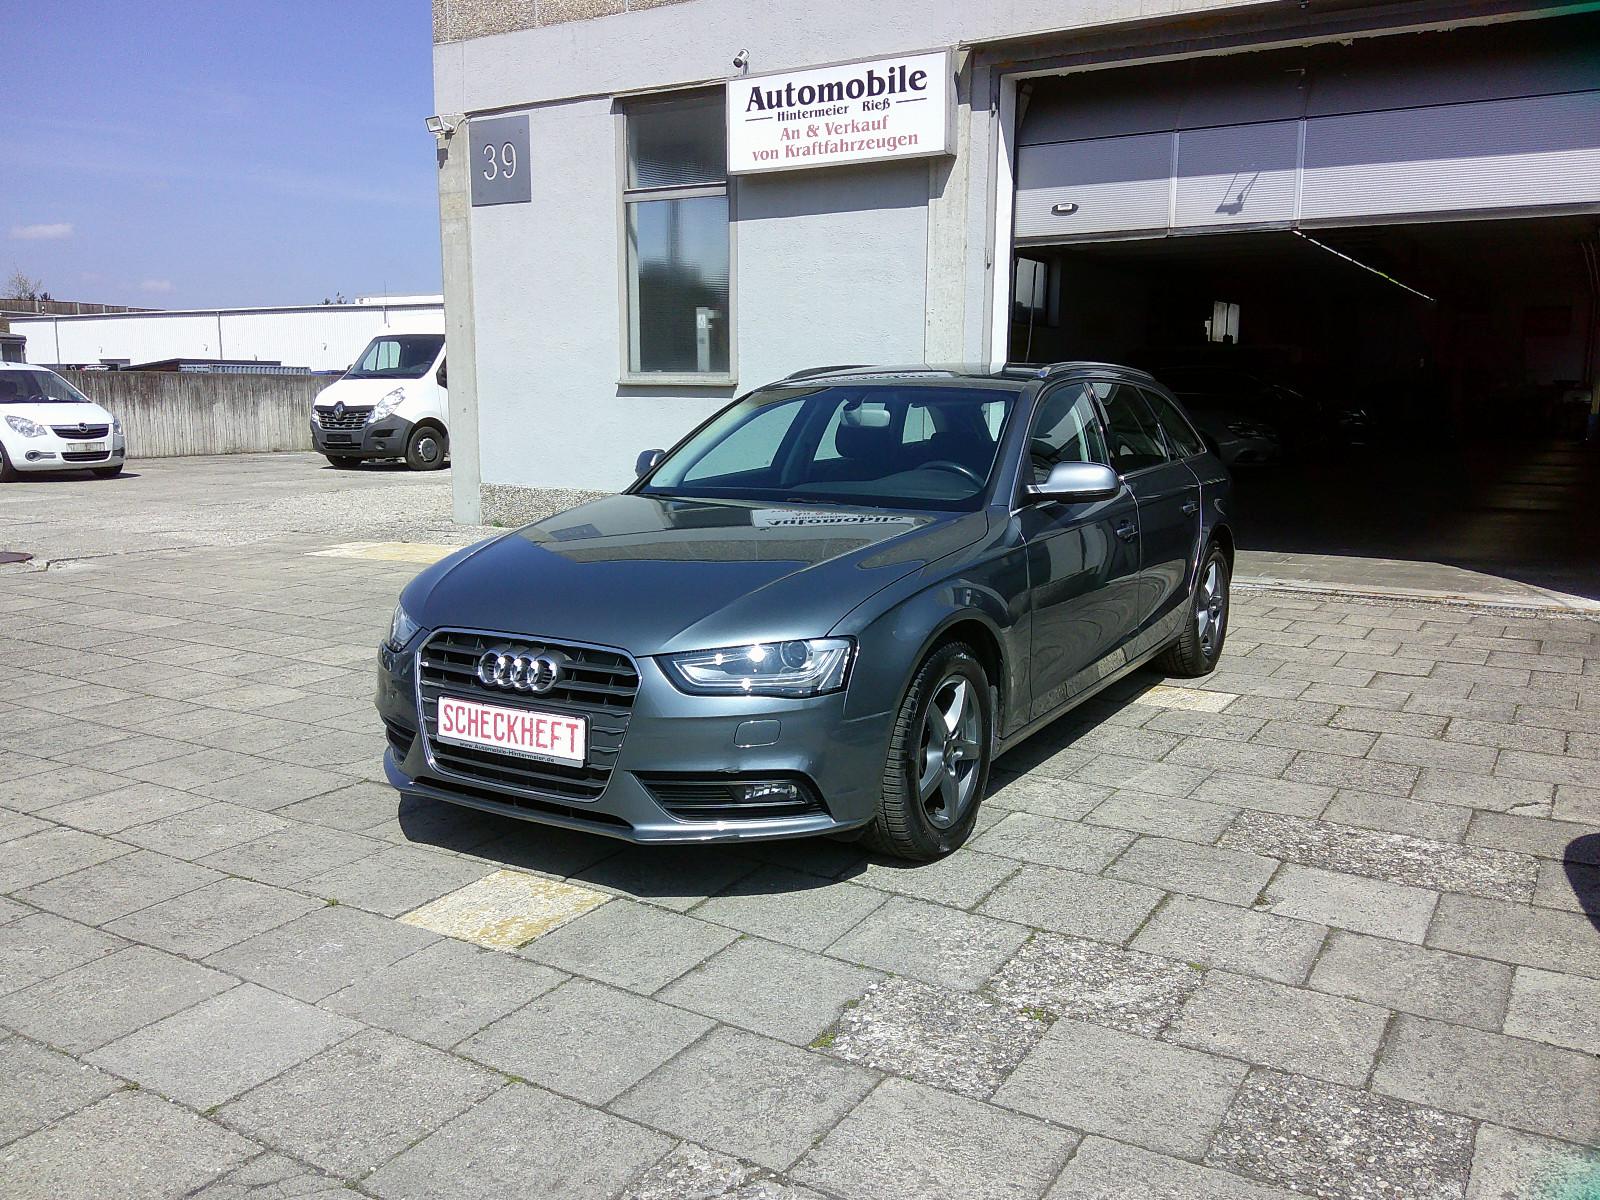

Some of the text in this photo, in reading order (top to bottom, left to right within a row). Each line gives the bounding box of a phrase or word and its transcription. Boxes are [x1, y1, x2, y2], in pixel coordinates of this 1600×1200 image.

[745, 65, 928, 112] Automobile
[777, 98, 891, 122] Hintermeier Rieß
[780, 115, 889, 142] An & Verkauf
[483, 142, 517, 181] 39
[752, 133, 919, 161] von Kraftfahrzeugen
[442, 703, 579, 753] SCHECKHEFT
